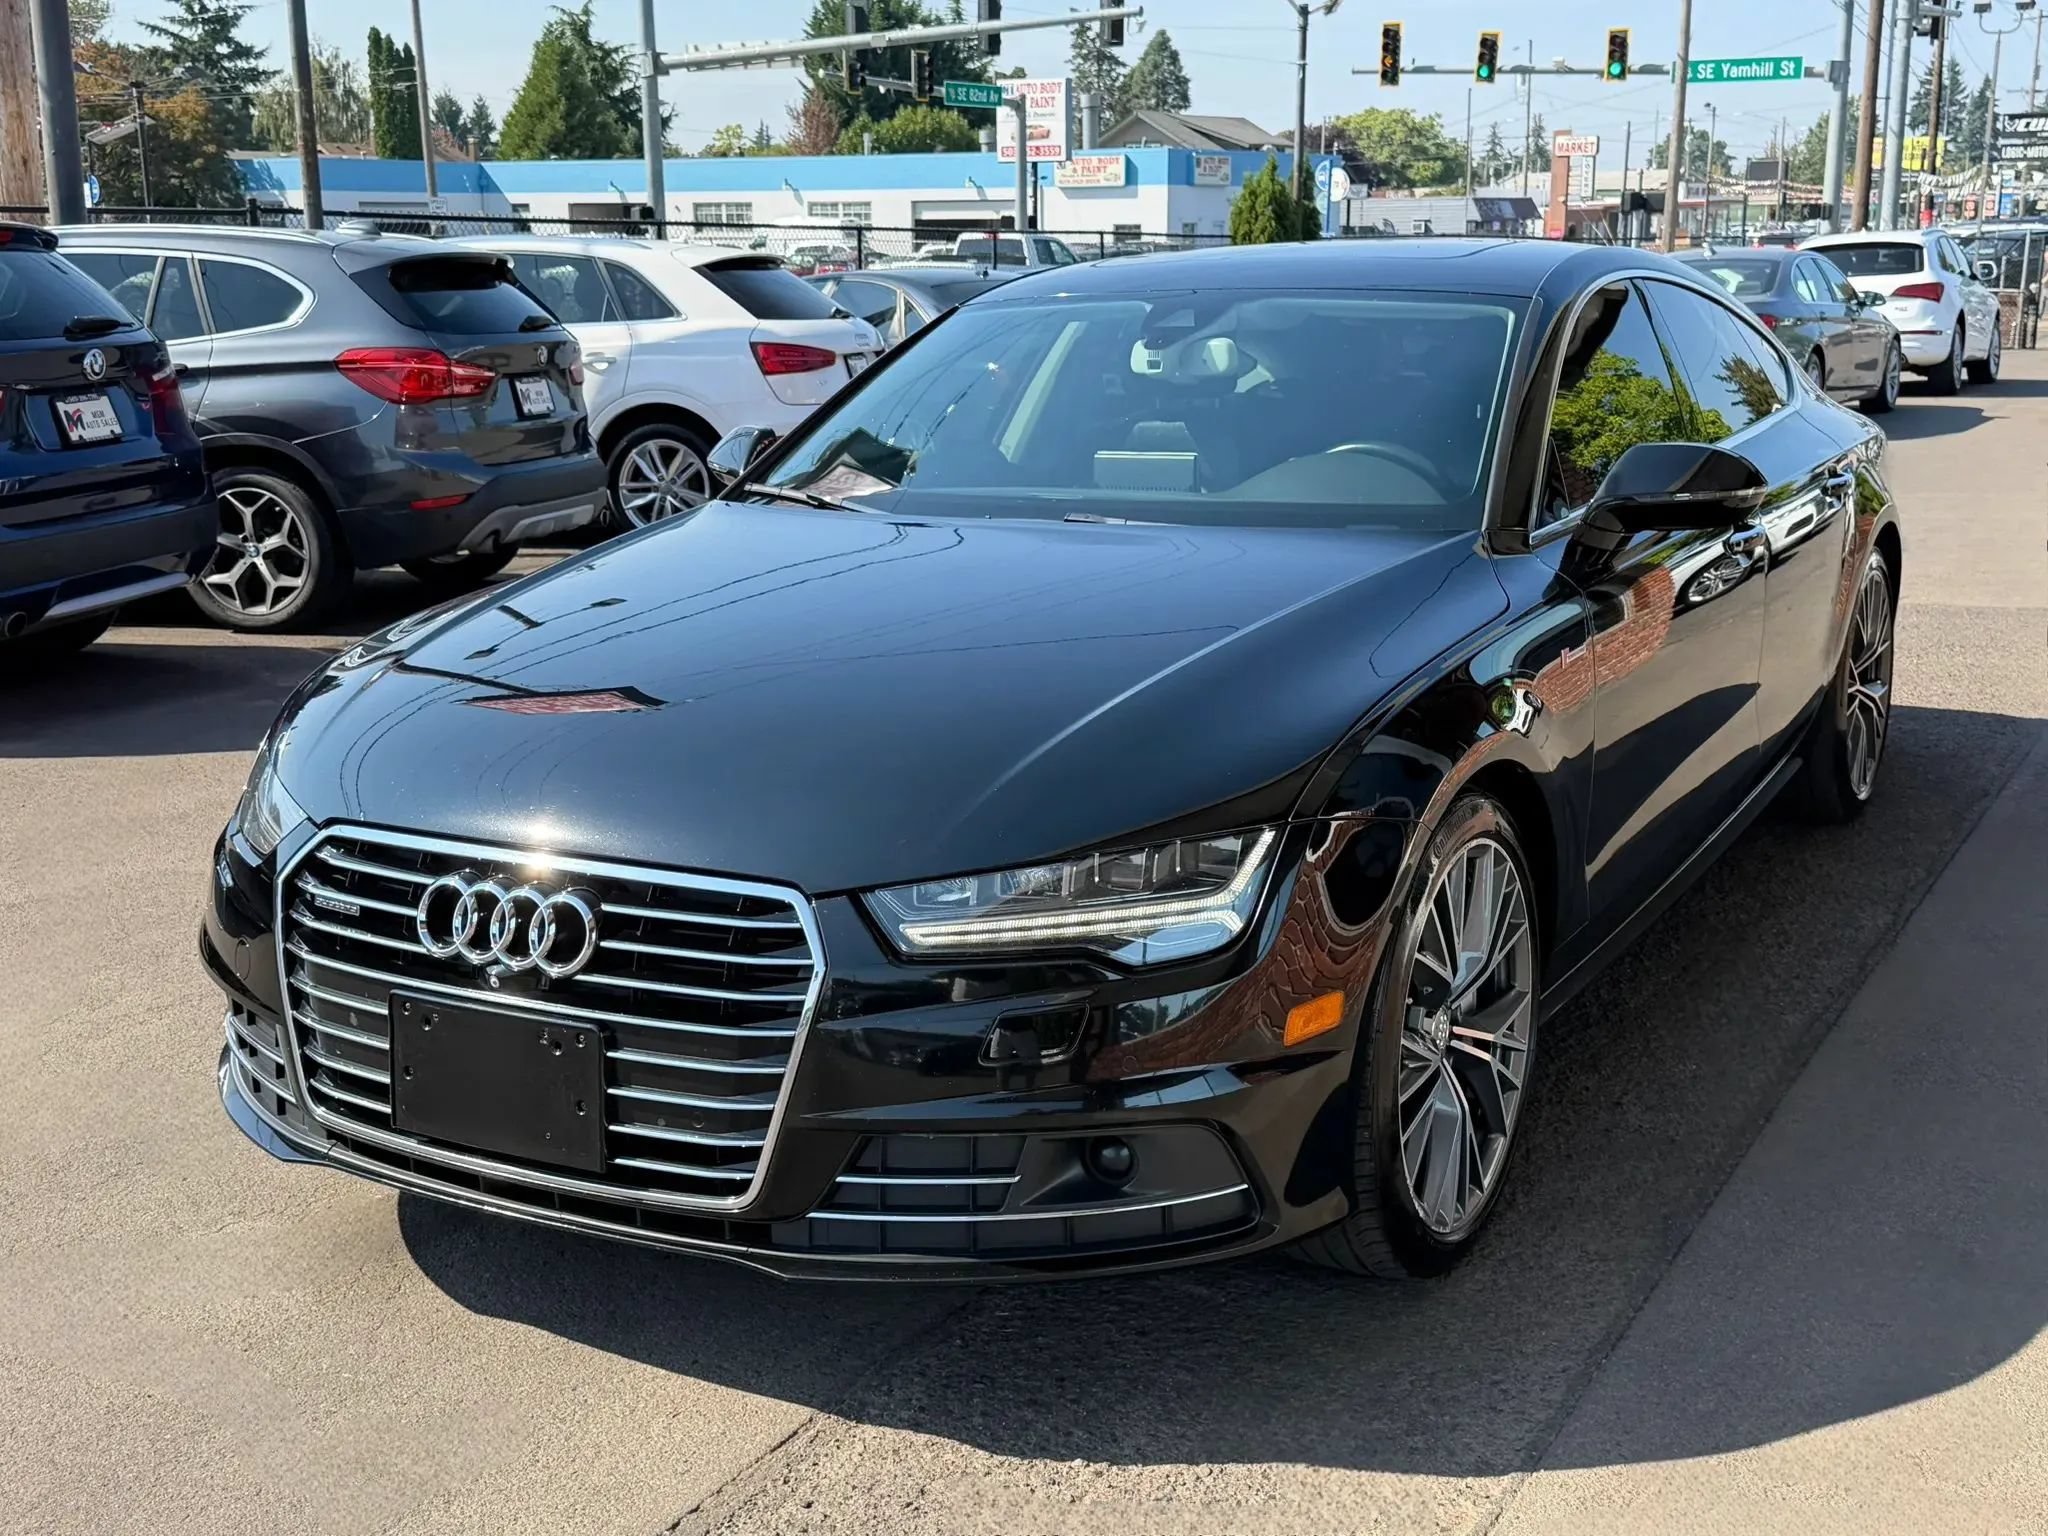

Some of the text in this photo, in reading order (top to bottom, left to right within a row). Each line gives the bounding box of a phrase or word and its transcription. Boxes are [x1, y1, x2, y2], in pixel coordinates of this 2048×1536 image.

[1697, 60, 1795, 79] SE Yamhill St
[1016, 83, 1038, 95] AUTO
[1040, 82, 1062, 94] BODY
[957, 87, 999, 103] SE 82nd Av
[1030, 97, 1056, 108] PAINT
[1557, 142, 1595, 153] MARKET
[1072, 157, 1120, 166] AUTO BODY
[1081, 166, 1108, 175] PAINT
[86, 417, 118, 429] AUTO SALES
